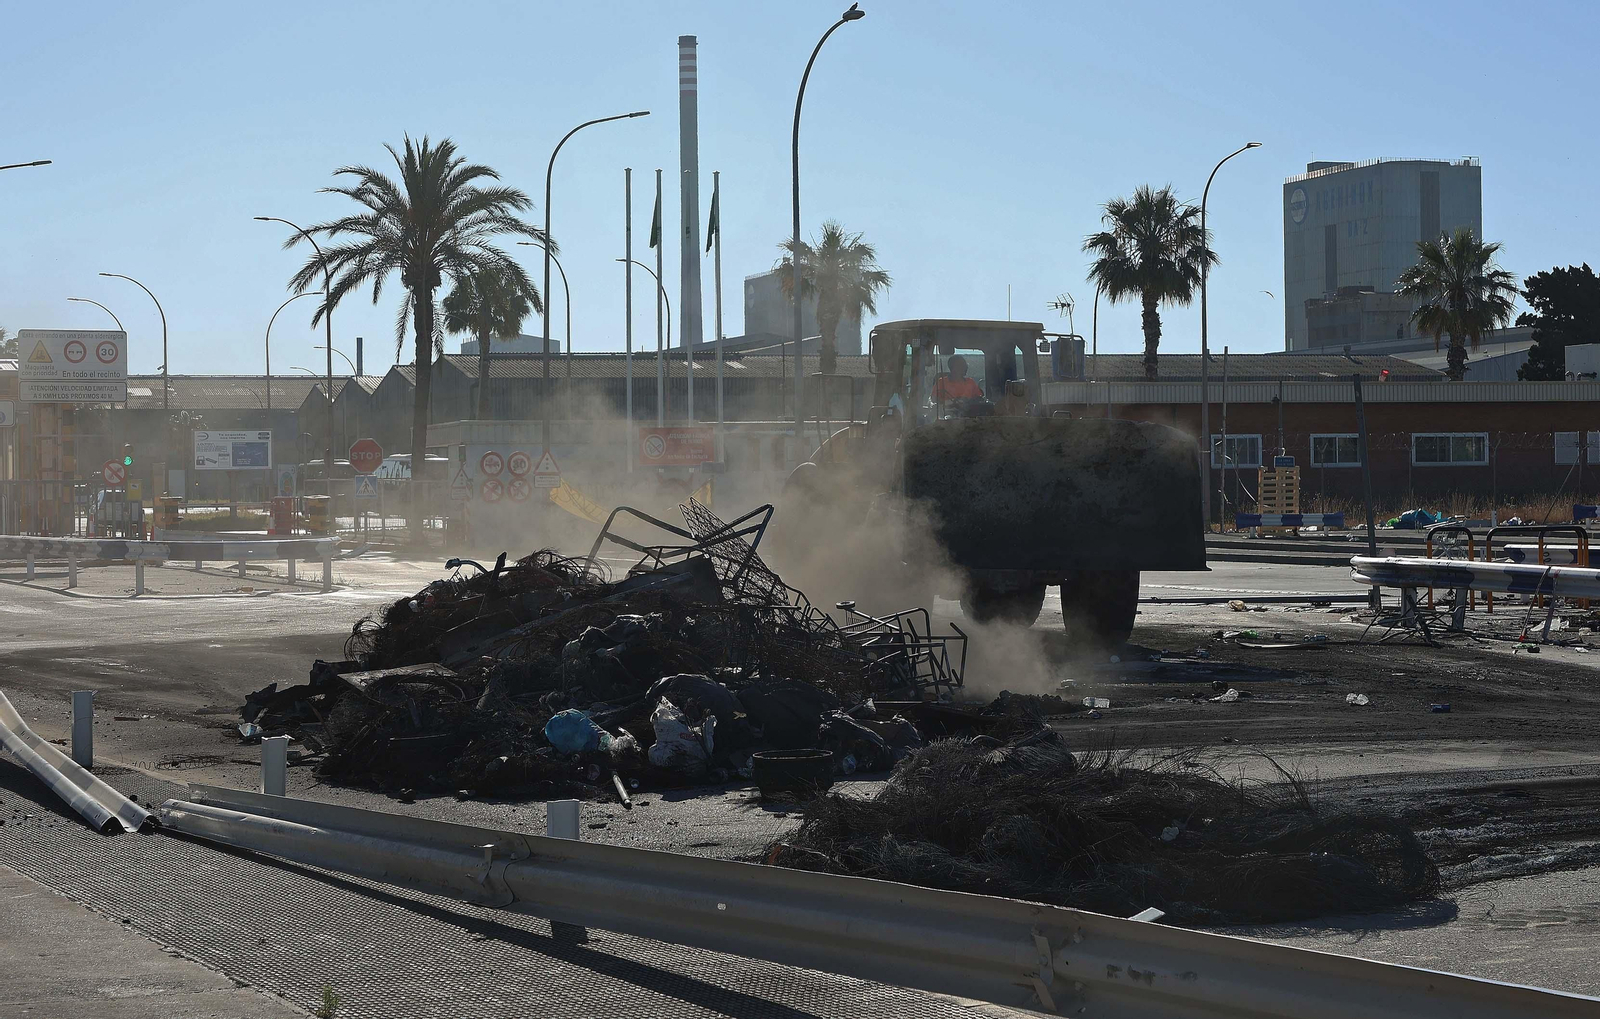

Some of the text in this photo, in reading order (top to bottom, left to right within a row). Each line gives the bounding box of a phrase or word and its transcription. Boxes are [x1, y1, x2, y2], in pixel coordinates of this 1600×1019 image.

[101, 348, 114, 356] 30
[62, 370, 121, 378] En todo el recinto
[351, 452, 381, 460] STOP
